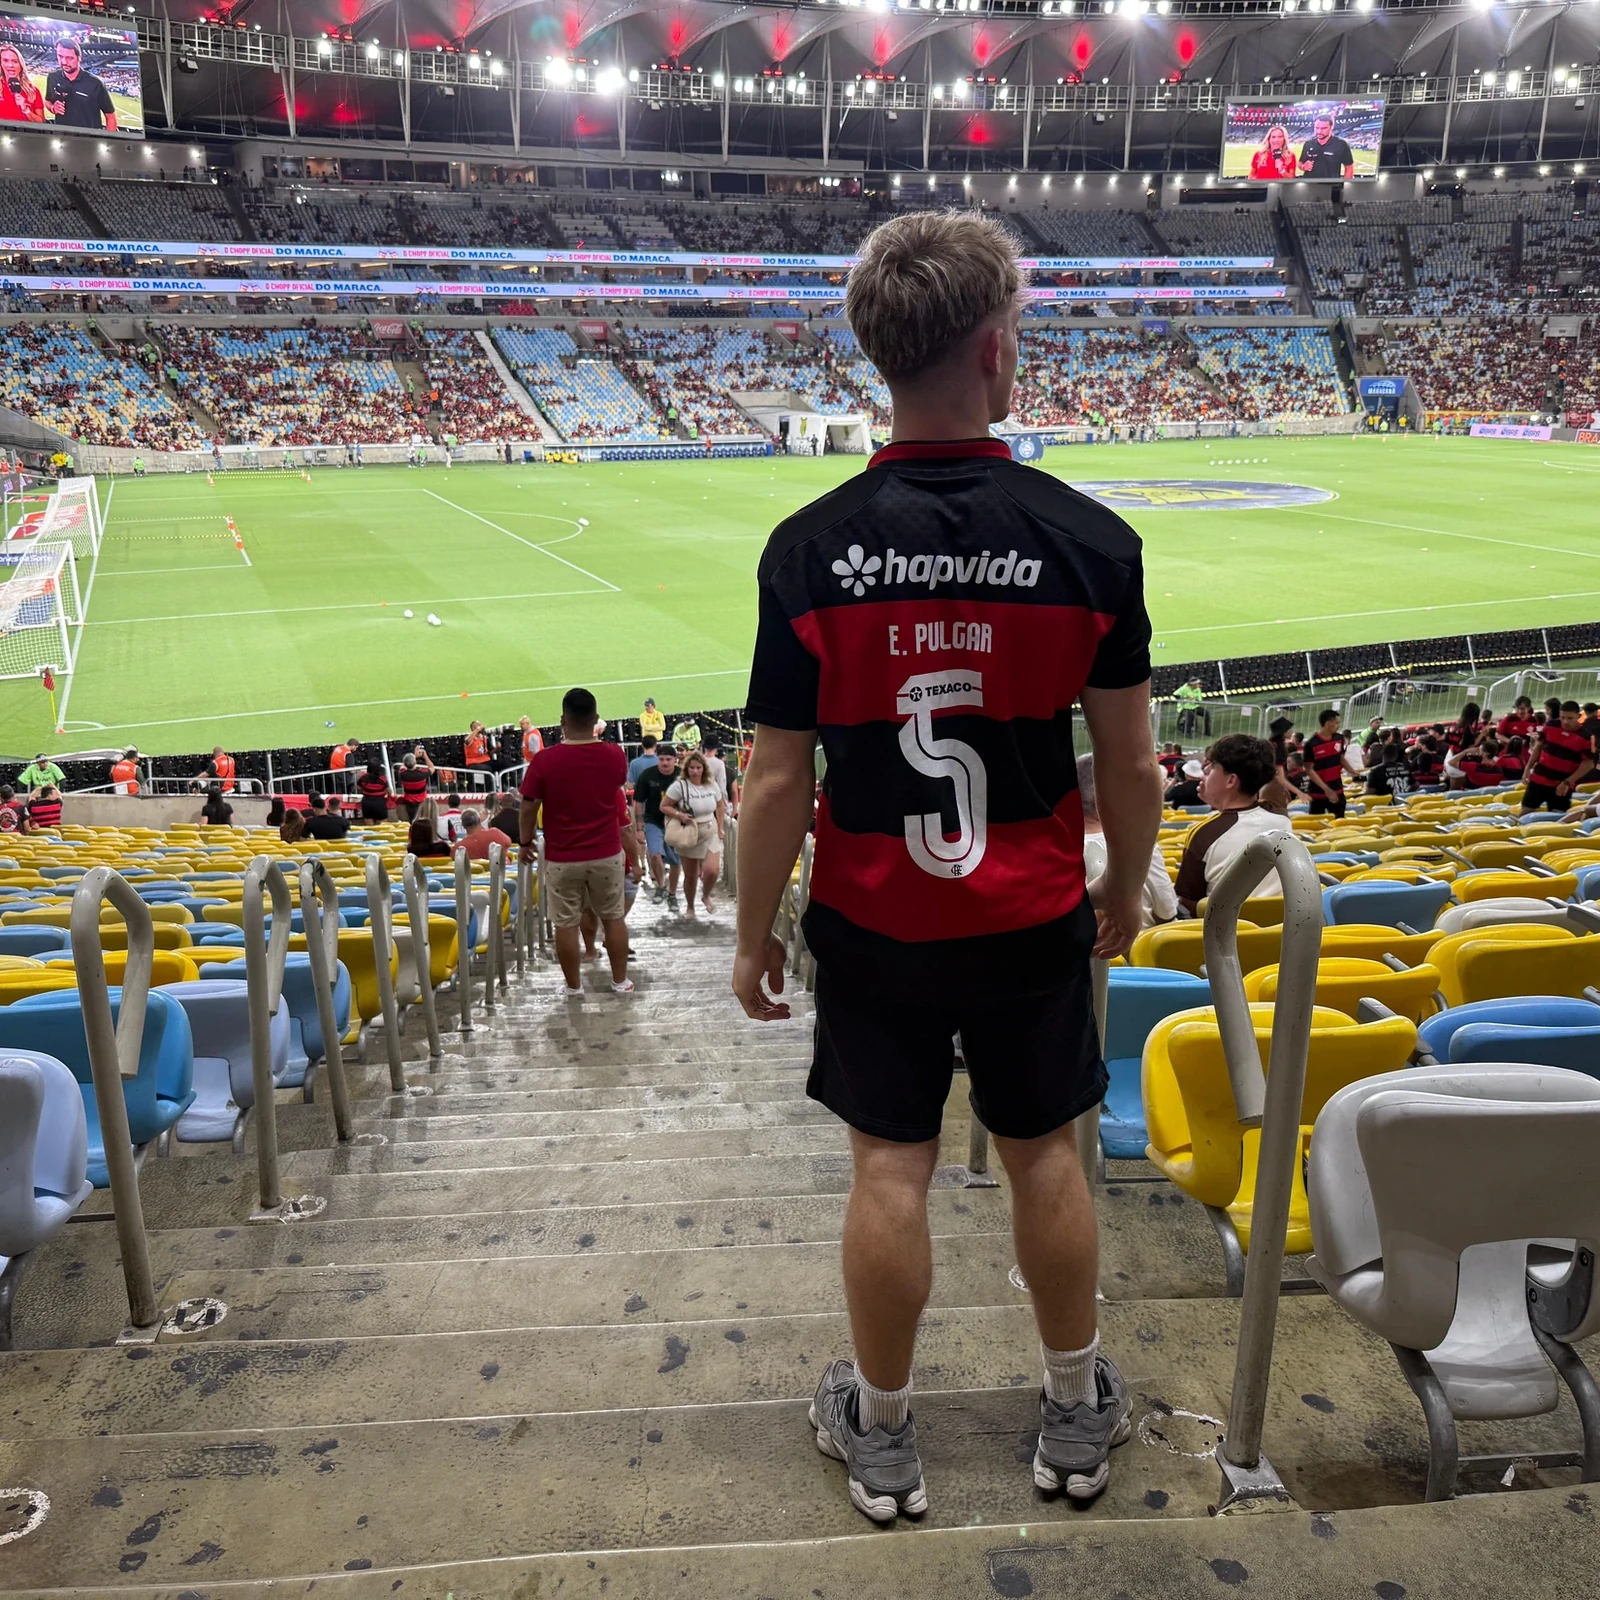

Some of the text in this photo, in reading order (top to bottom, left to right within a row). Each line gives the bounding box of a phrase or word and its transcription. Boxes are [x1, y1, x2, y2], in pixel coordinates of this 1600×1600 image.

[107, 281, 131, 289] OFICIAL
[133, 281, 149, 289] DO
[884, 548, 1042, 590] hapvida
[888, 621, 992, 656] E. PULGAR
[925, 682, 972, 697] TEXACO
[896, 668, 988, 878] 5
